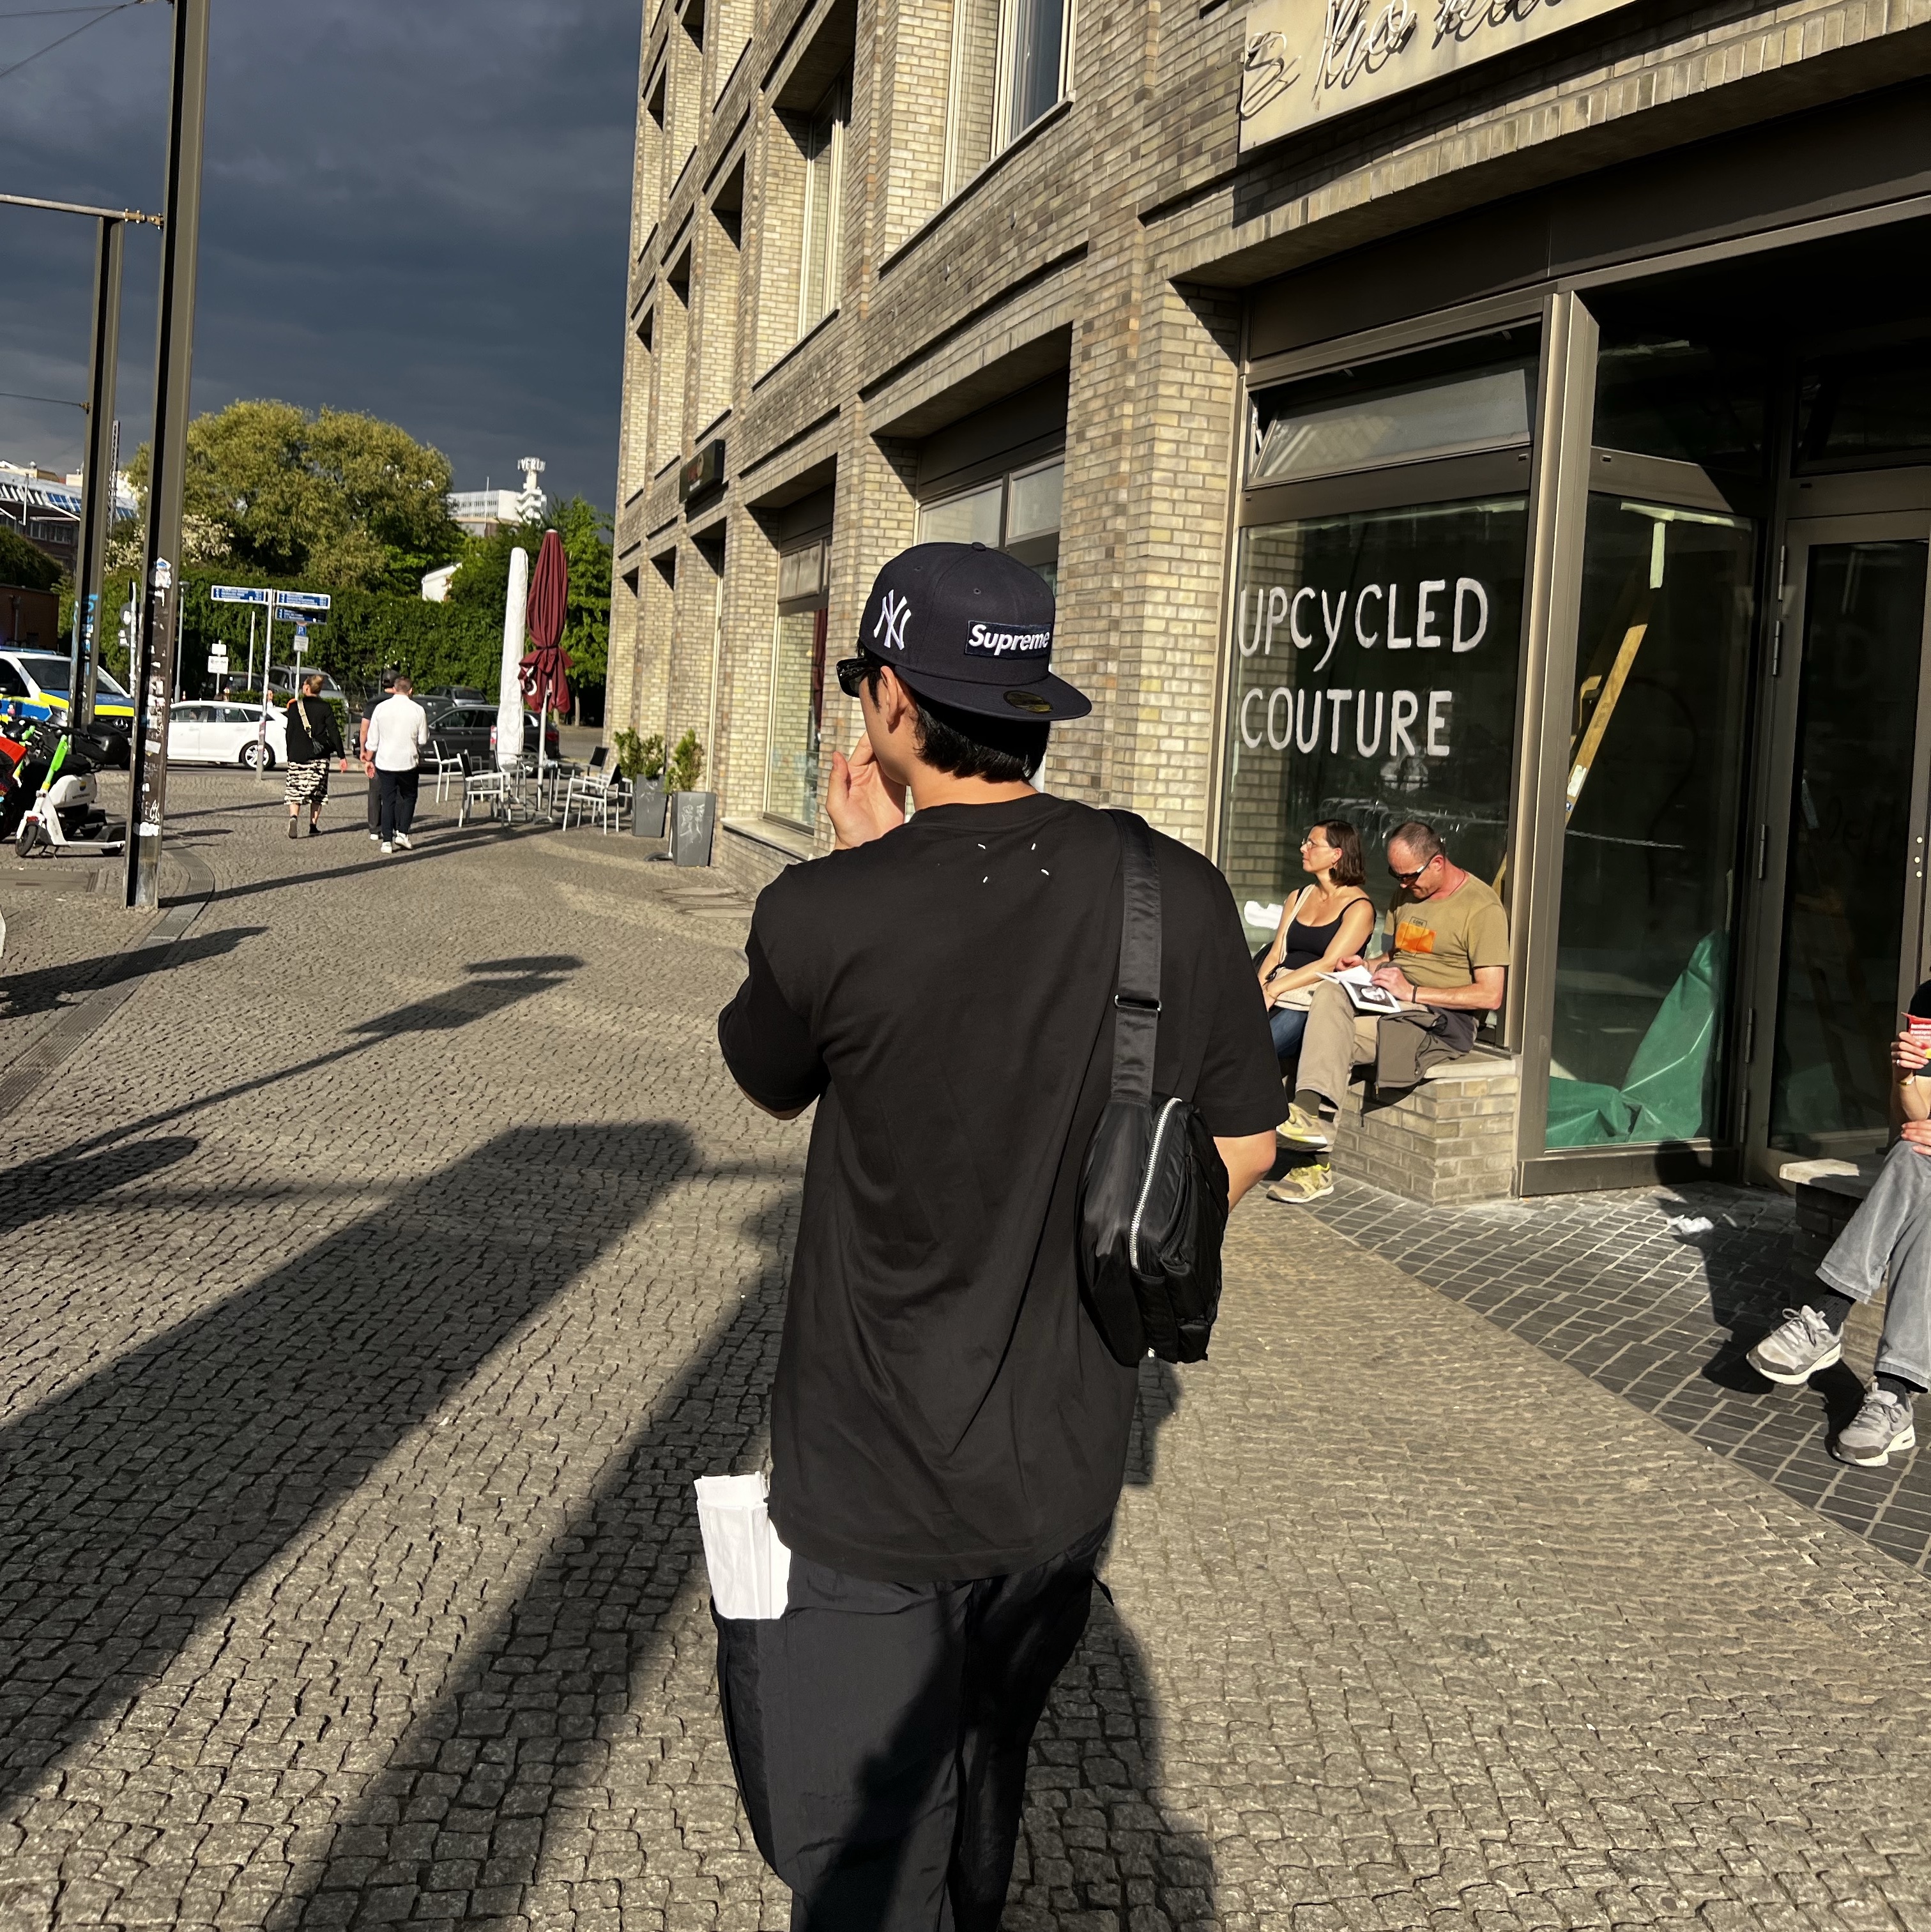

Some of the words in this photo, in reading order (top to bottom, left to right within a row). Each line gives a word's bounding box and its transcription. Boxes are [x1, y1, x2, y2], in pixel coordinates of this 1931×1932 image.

[873, 589, 912, 651] NY
[968, 625, 1049, 655] Supreme
[1240, 687, 1453, 757] COUTURE
